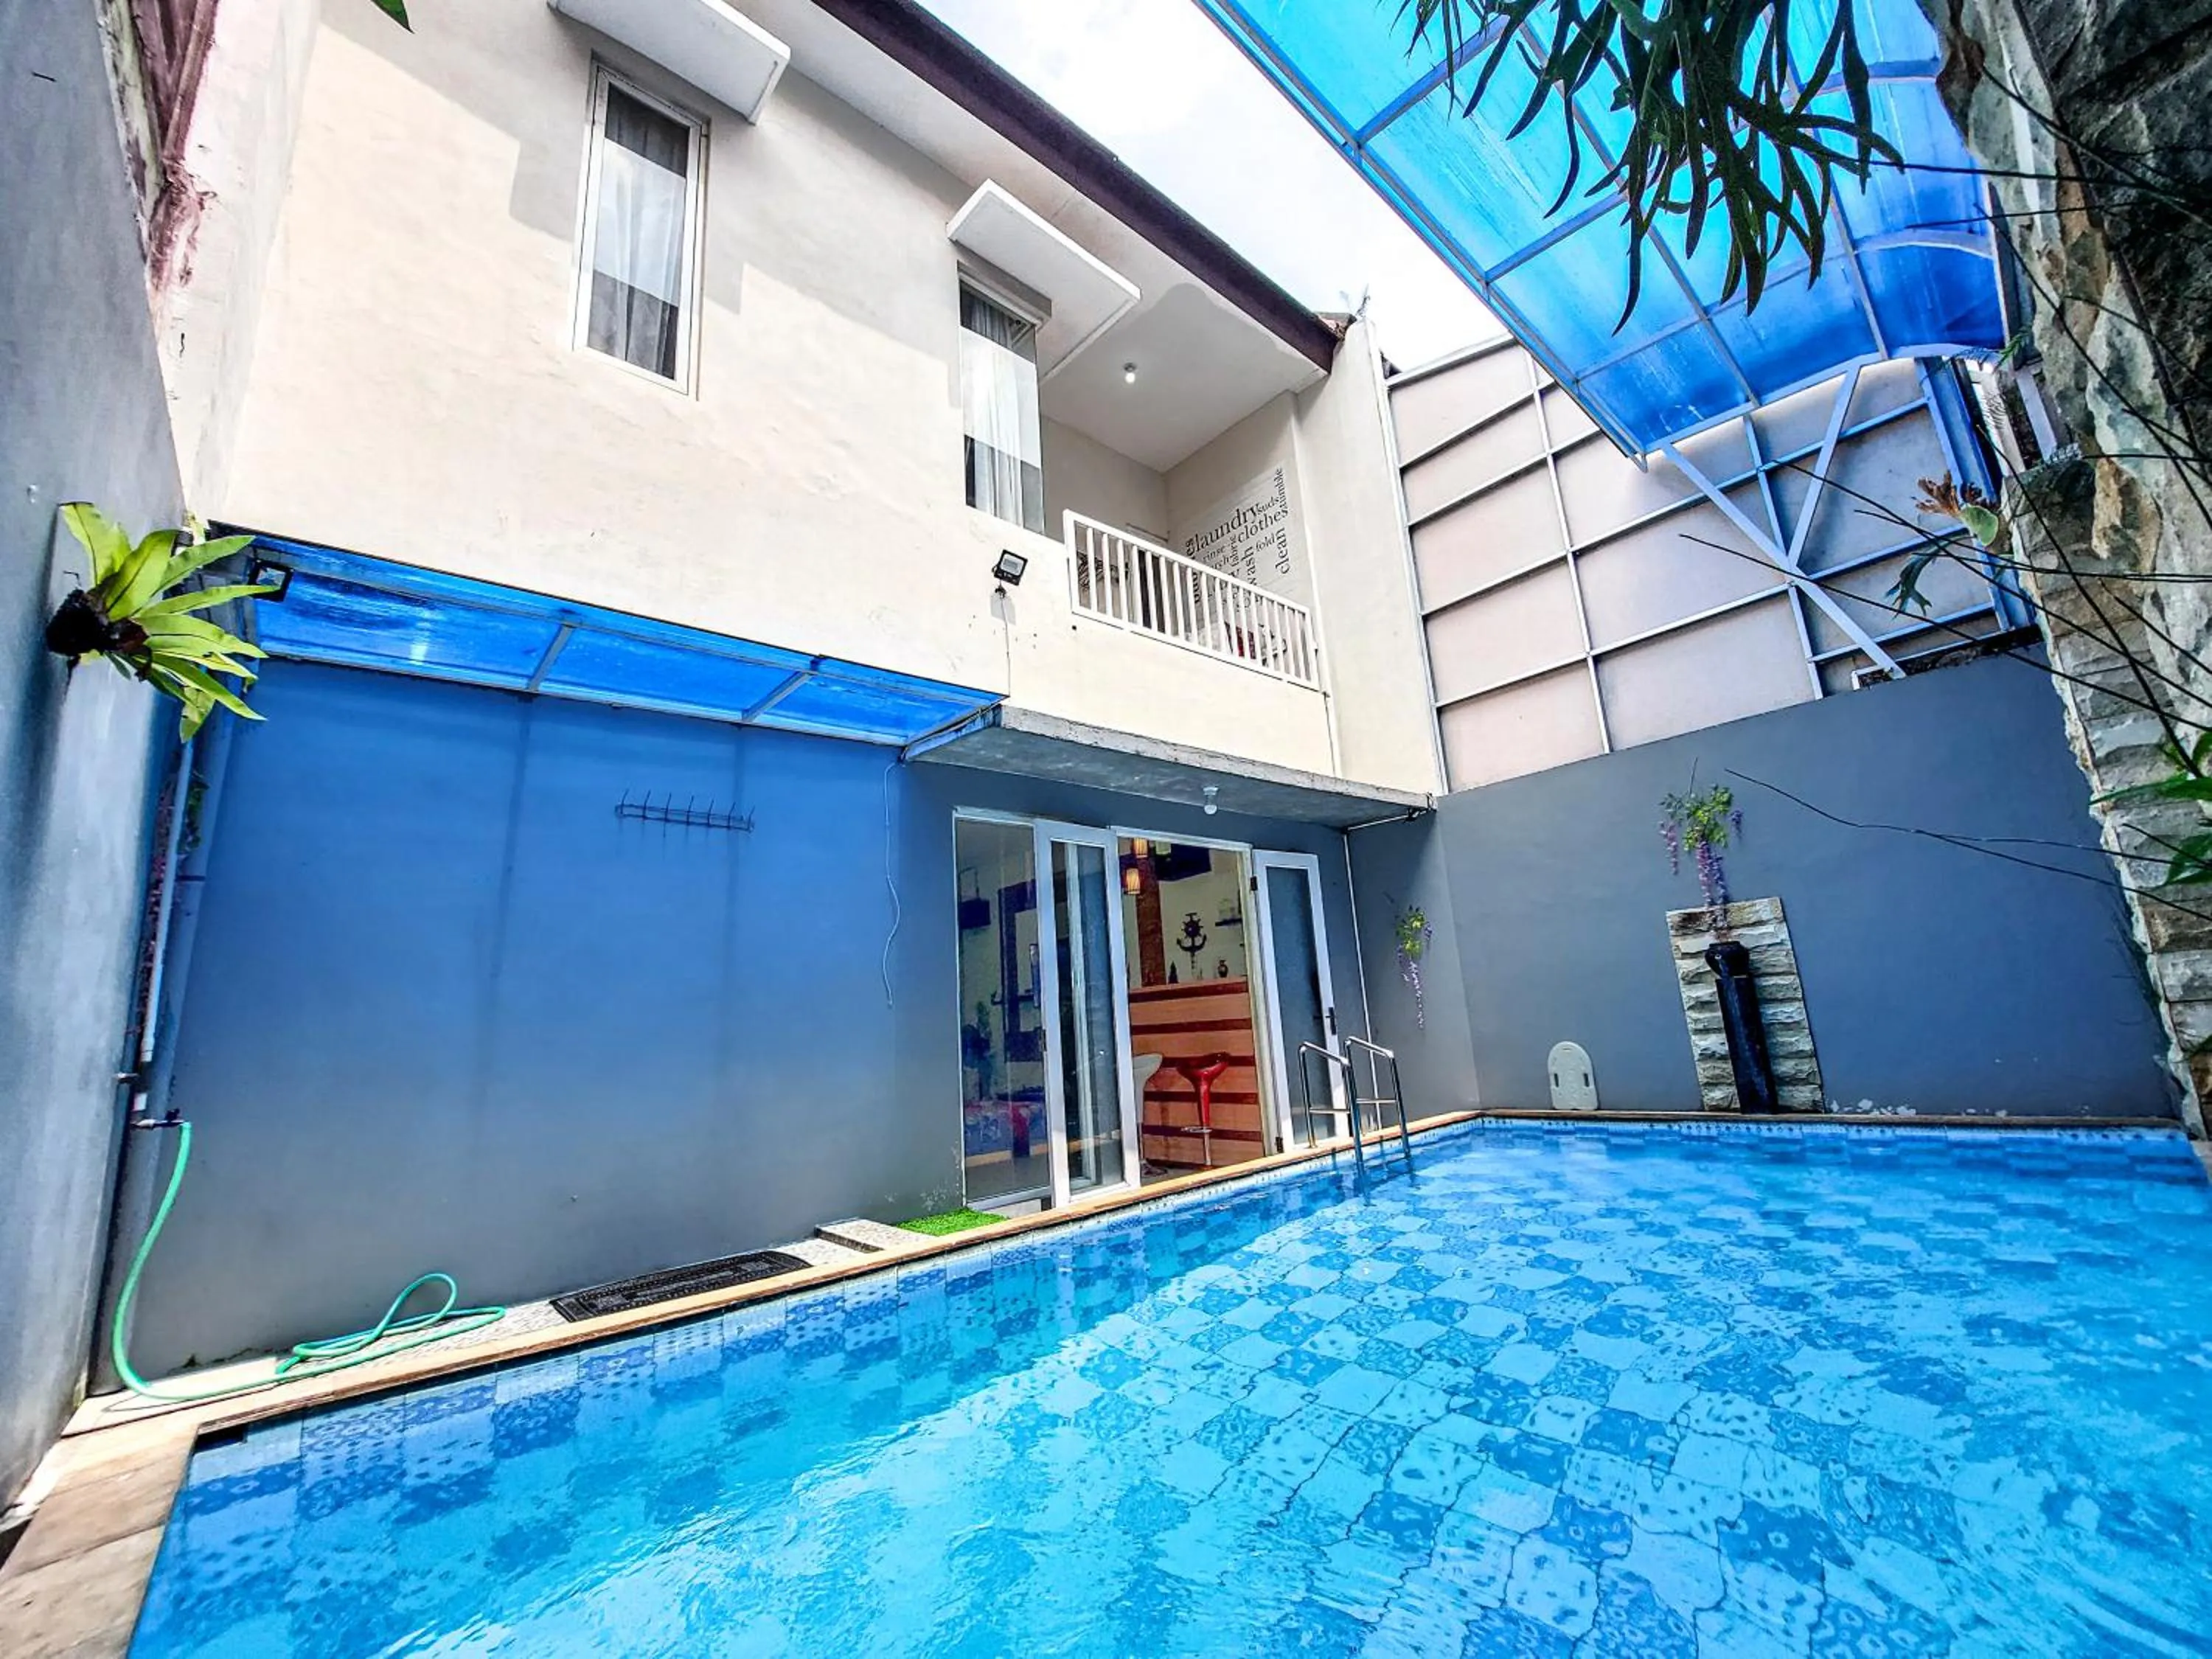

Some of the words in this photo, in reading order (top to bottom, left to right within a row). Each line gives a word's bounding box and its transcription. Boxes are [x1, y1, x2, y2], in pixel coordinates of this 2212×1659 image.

[1194, 506, 1258, 553] laundry
[1238, 509, 1289, 543] clothes
[1274, 527, 1291, 574] clean
